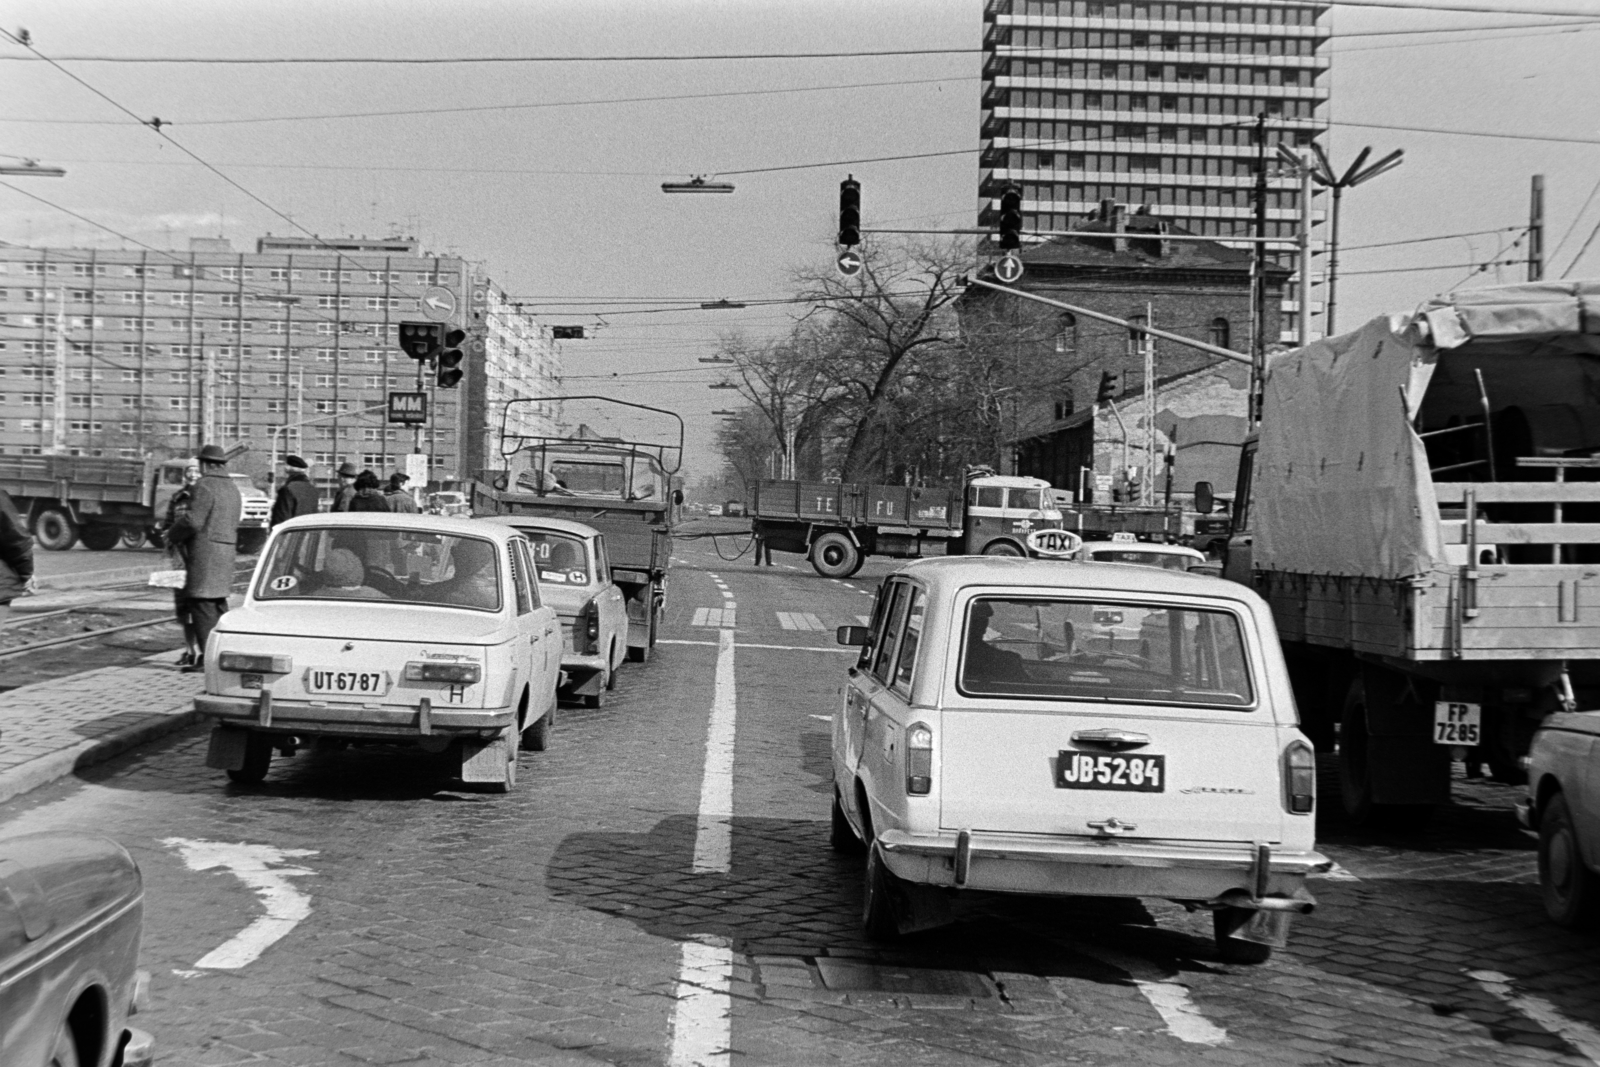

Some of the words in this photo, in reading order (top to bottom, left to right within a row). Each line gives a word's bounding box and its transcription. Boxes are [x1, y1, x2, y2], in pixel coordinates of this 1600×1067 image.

[393, 396, 422, 411] MM
[816, 497, 833, 512] TE
[876, 501, 893, 516] FU
[1036, 533, 1073, 551] TAXI
[277, 578, 290, 589] H
[573, 572, 583, 581] H
[450, 685, 465, 704] H
[1447, 703, 1469, 722] FP
